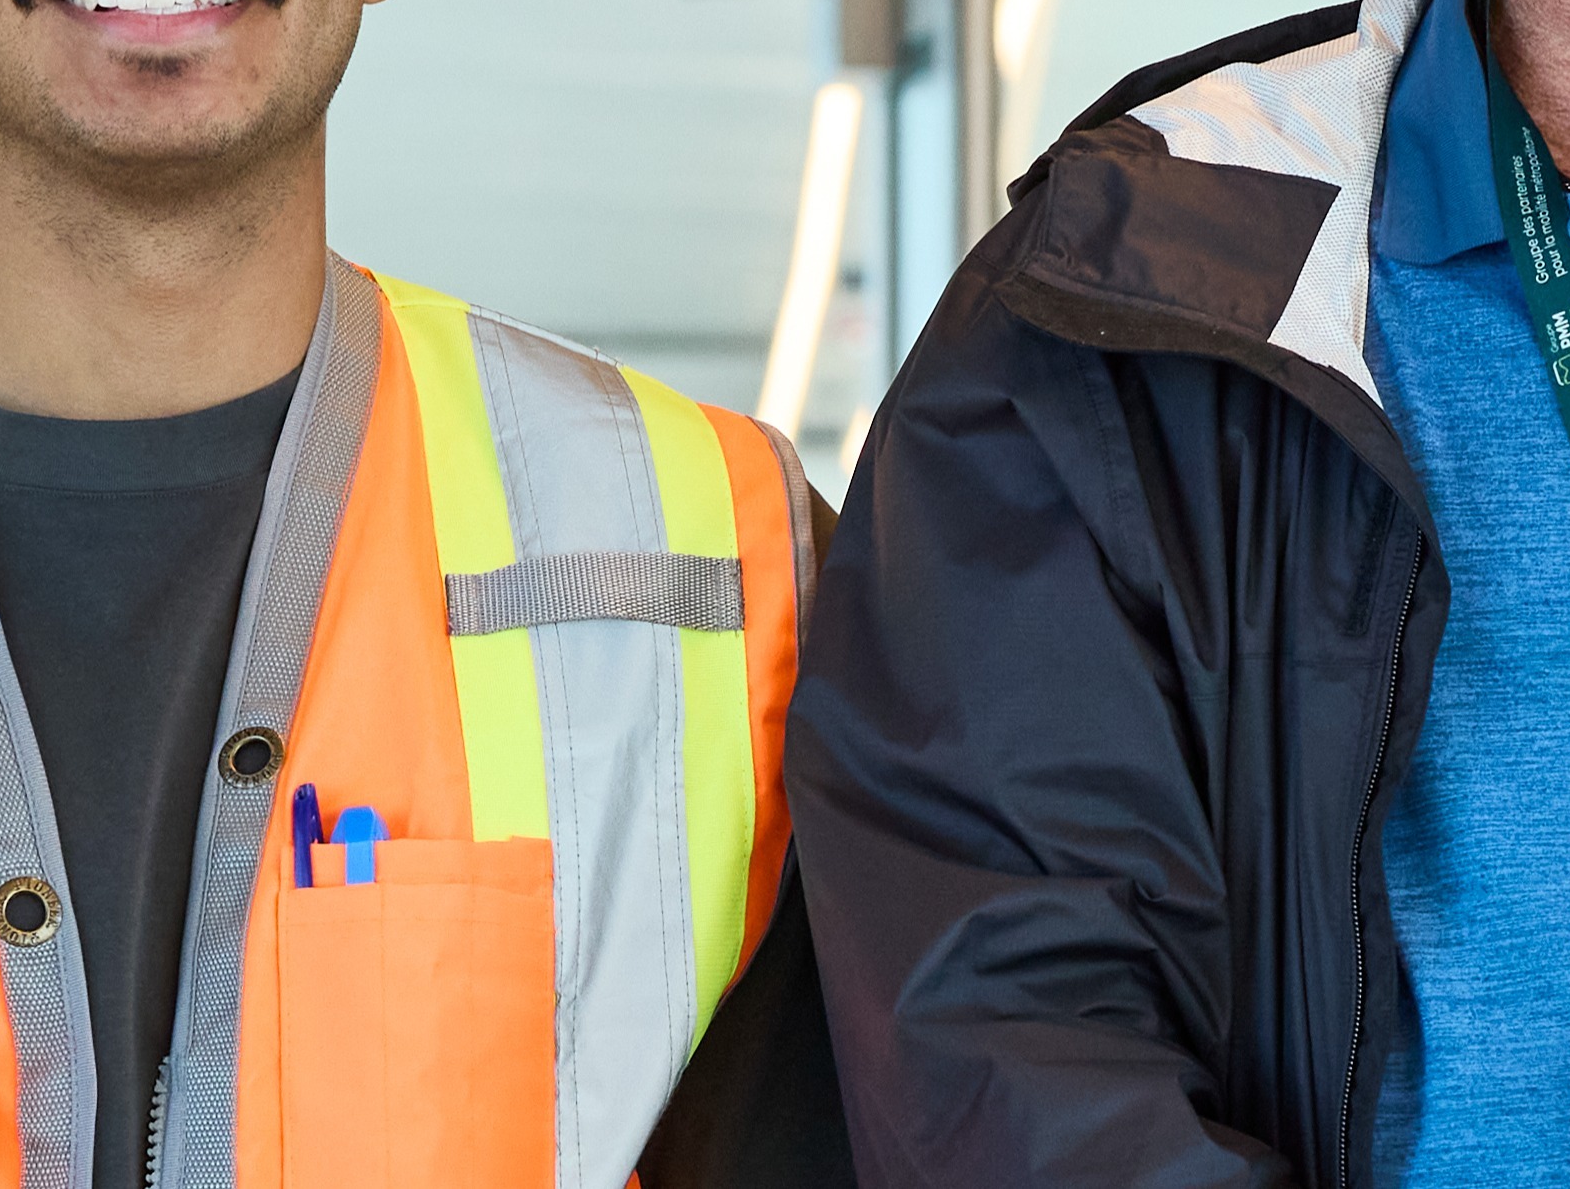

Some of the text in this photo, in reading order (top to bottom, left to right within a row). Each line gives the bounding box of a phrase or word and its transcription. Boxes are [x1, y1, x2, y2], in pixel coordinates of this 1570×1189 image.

[1512, 155, 1549, 284] Groupe des partenaires
[1534, 194, 1552, 235] mobilité
[1545, 235, 1555, 250] la
[1549, 249, 1568, 278] pour
